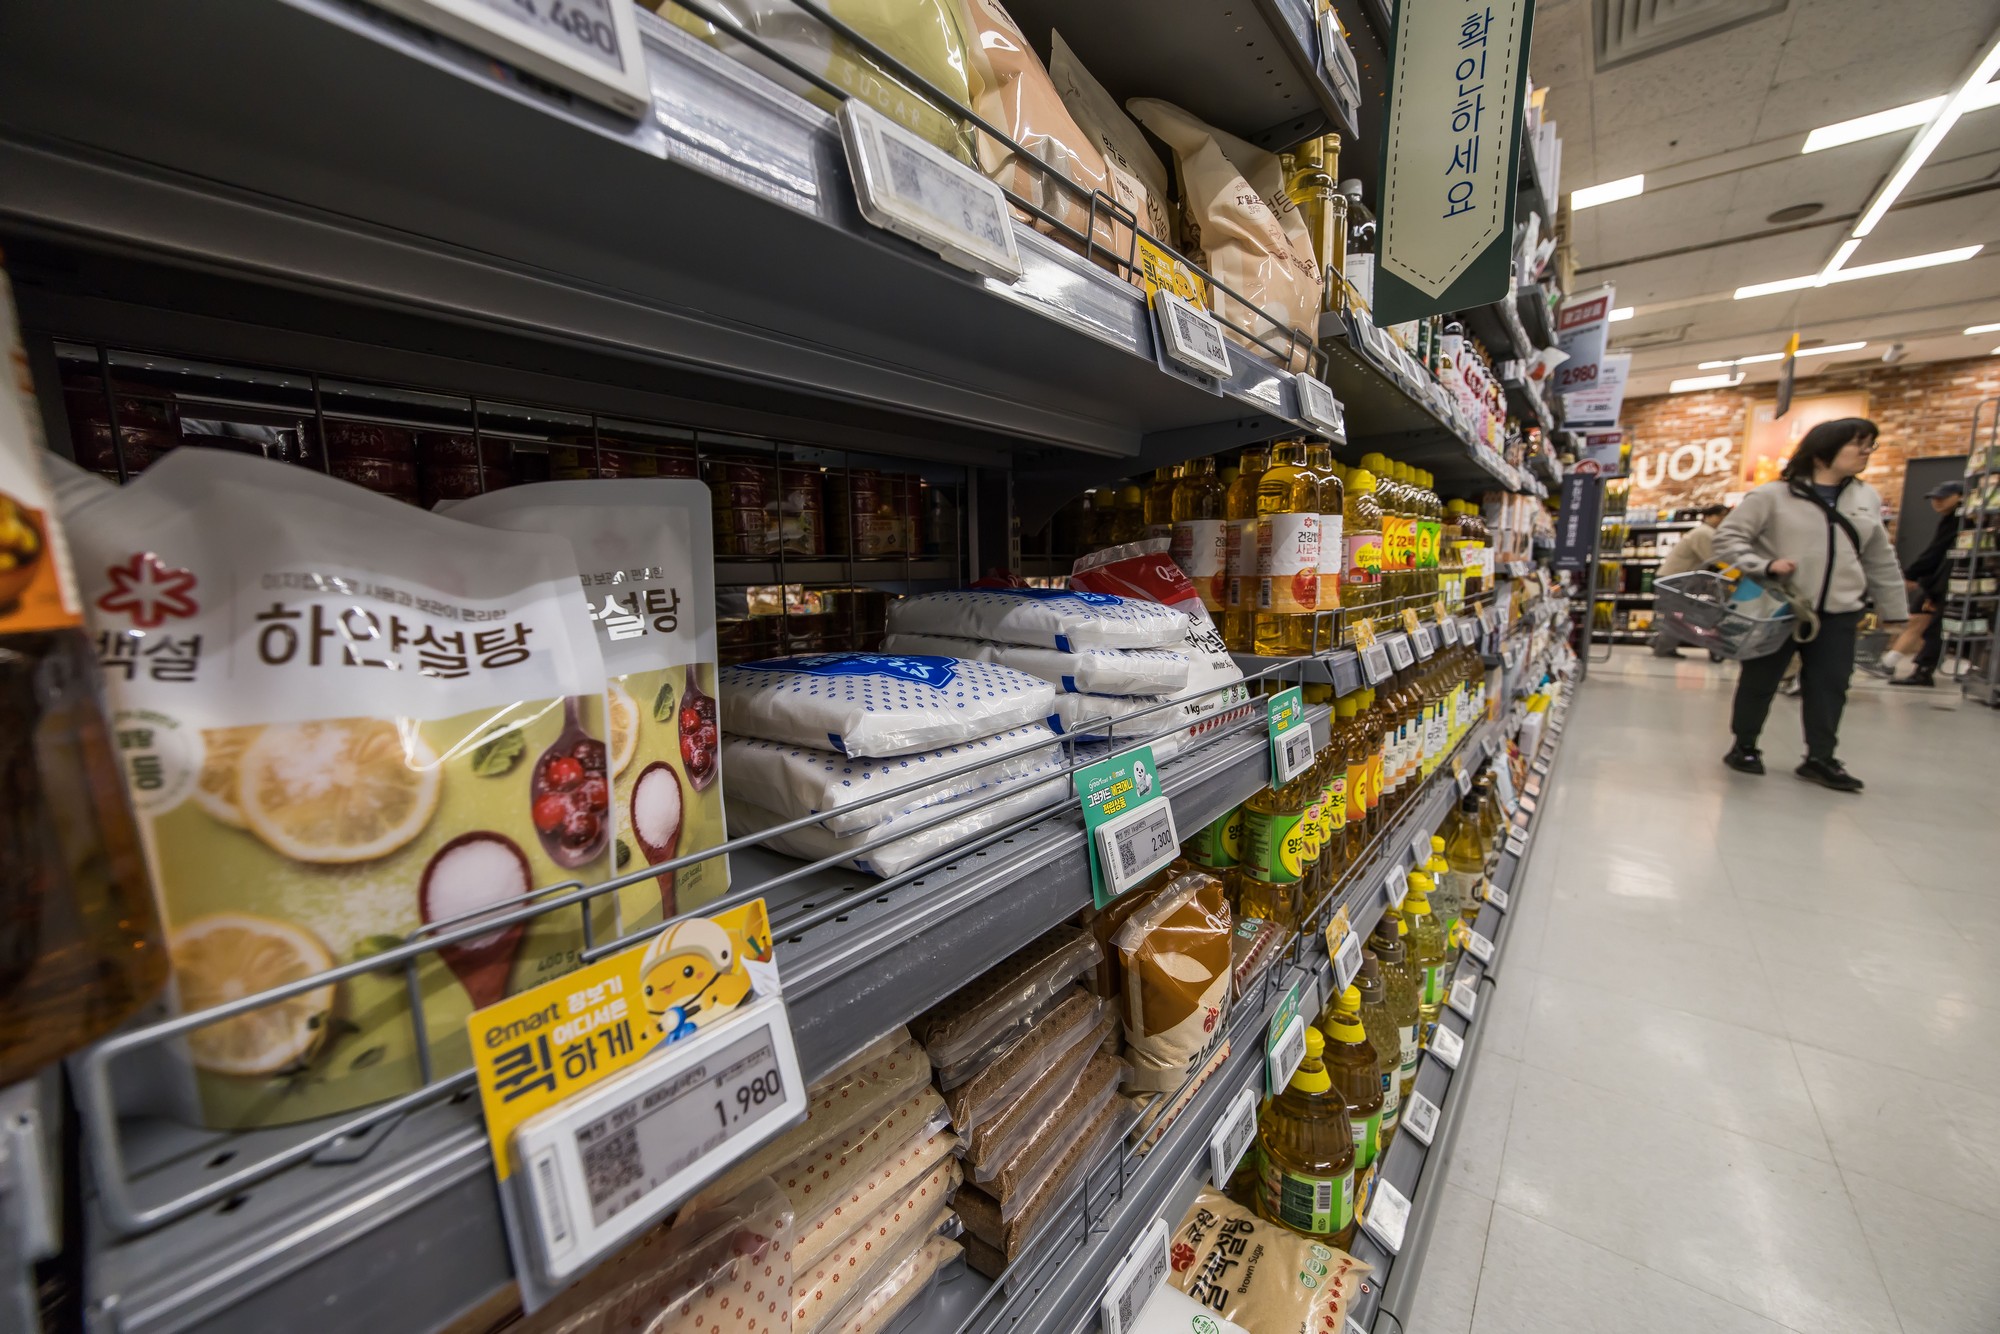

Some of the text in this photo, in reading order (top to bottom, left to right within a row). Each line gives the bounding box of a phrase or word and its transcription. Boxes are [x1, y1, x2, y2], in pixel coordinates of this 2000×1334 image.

[843, 66, 921, 128] SUGAR
[1443, 7, 1494, 218] 확인하세요
[98, 629, 203, 682] 백설
[255, 602, 533, 679] 하얀설탕
[1087, 787, 1112, 808] 그린카드
[1151, 829, 1171, 852] 2.300
[566, 974, 624, 1015] 장보기
[485, 1002, 561, 1049] emart
[552, 997, 629, 1046] 어디서든
[493, 1019, 634, 1104] 퀵 하게
[714, 1069, 781, 1128] 1.980
[1238, 1243, 1264, 1294] Brown Sugar
